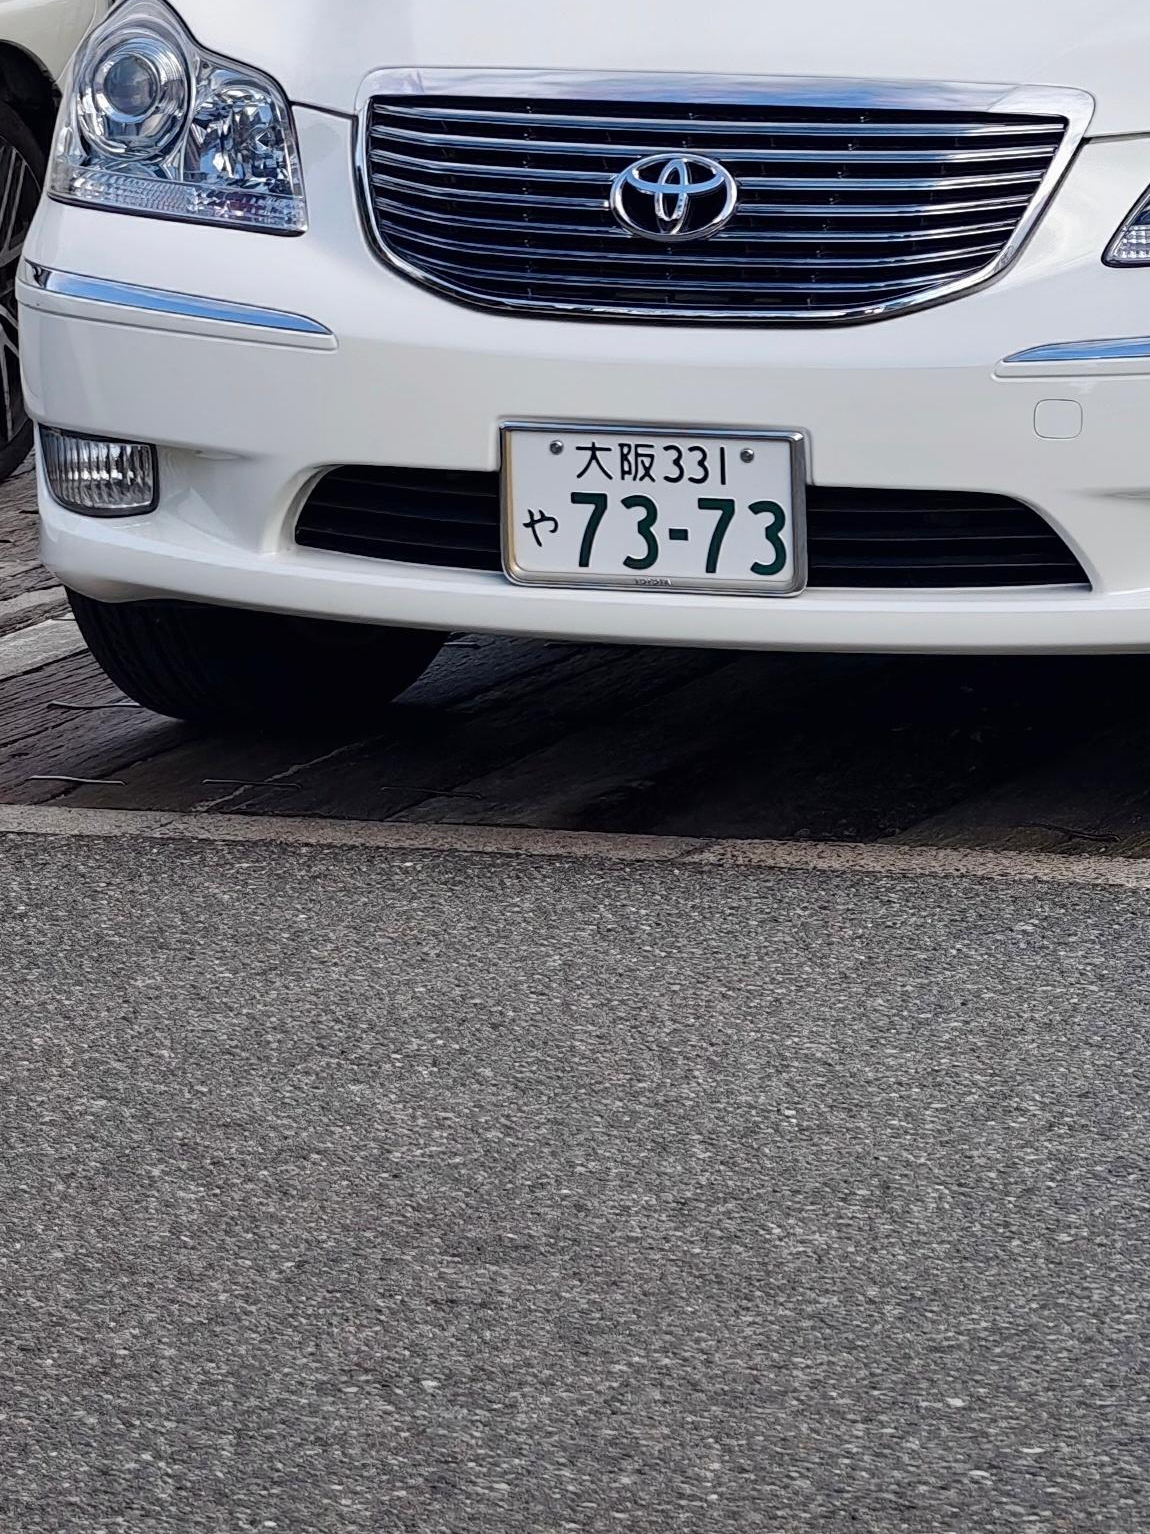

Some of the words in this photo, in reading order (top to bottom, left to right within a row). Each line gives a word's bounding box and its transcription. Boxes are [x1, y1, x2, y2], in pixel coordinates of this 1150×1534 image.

[575, 442, 727, 486] 大阪331
[523, 508, 559, 547] や
[570, 491, 787, 576] 73-73
